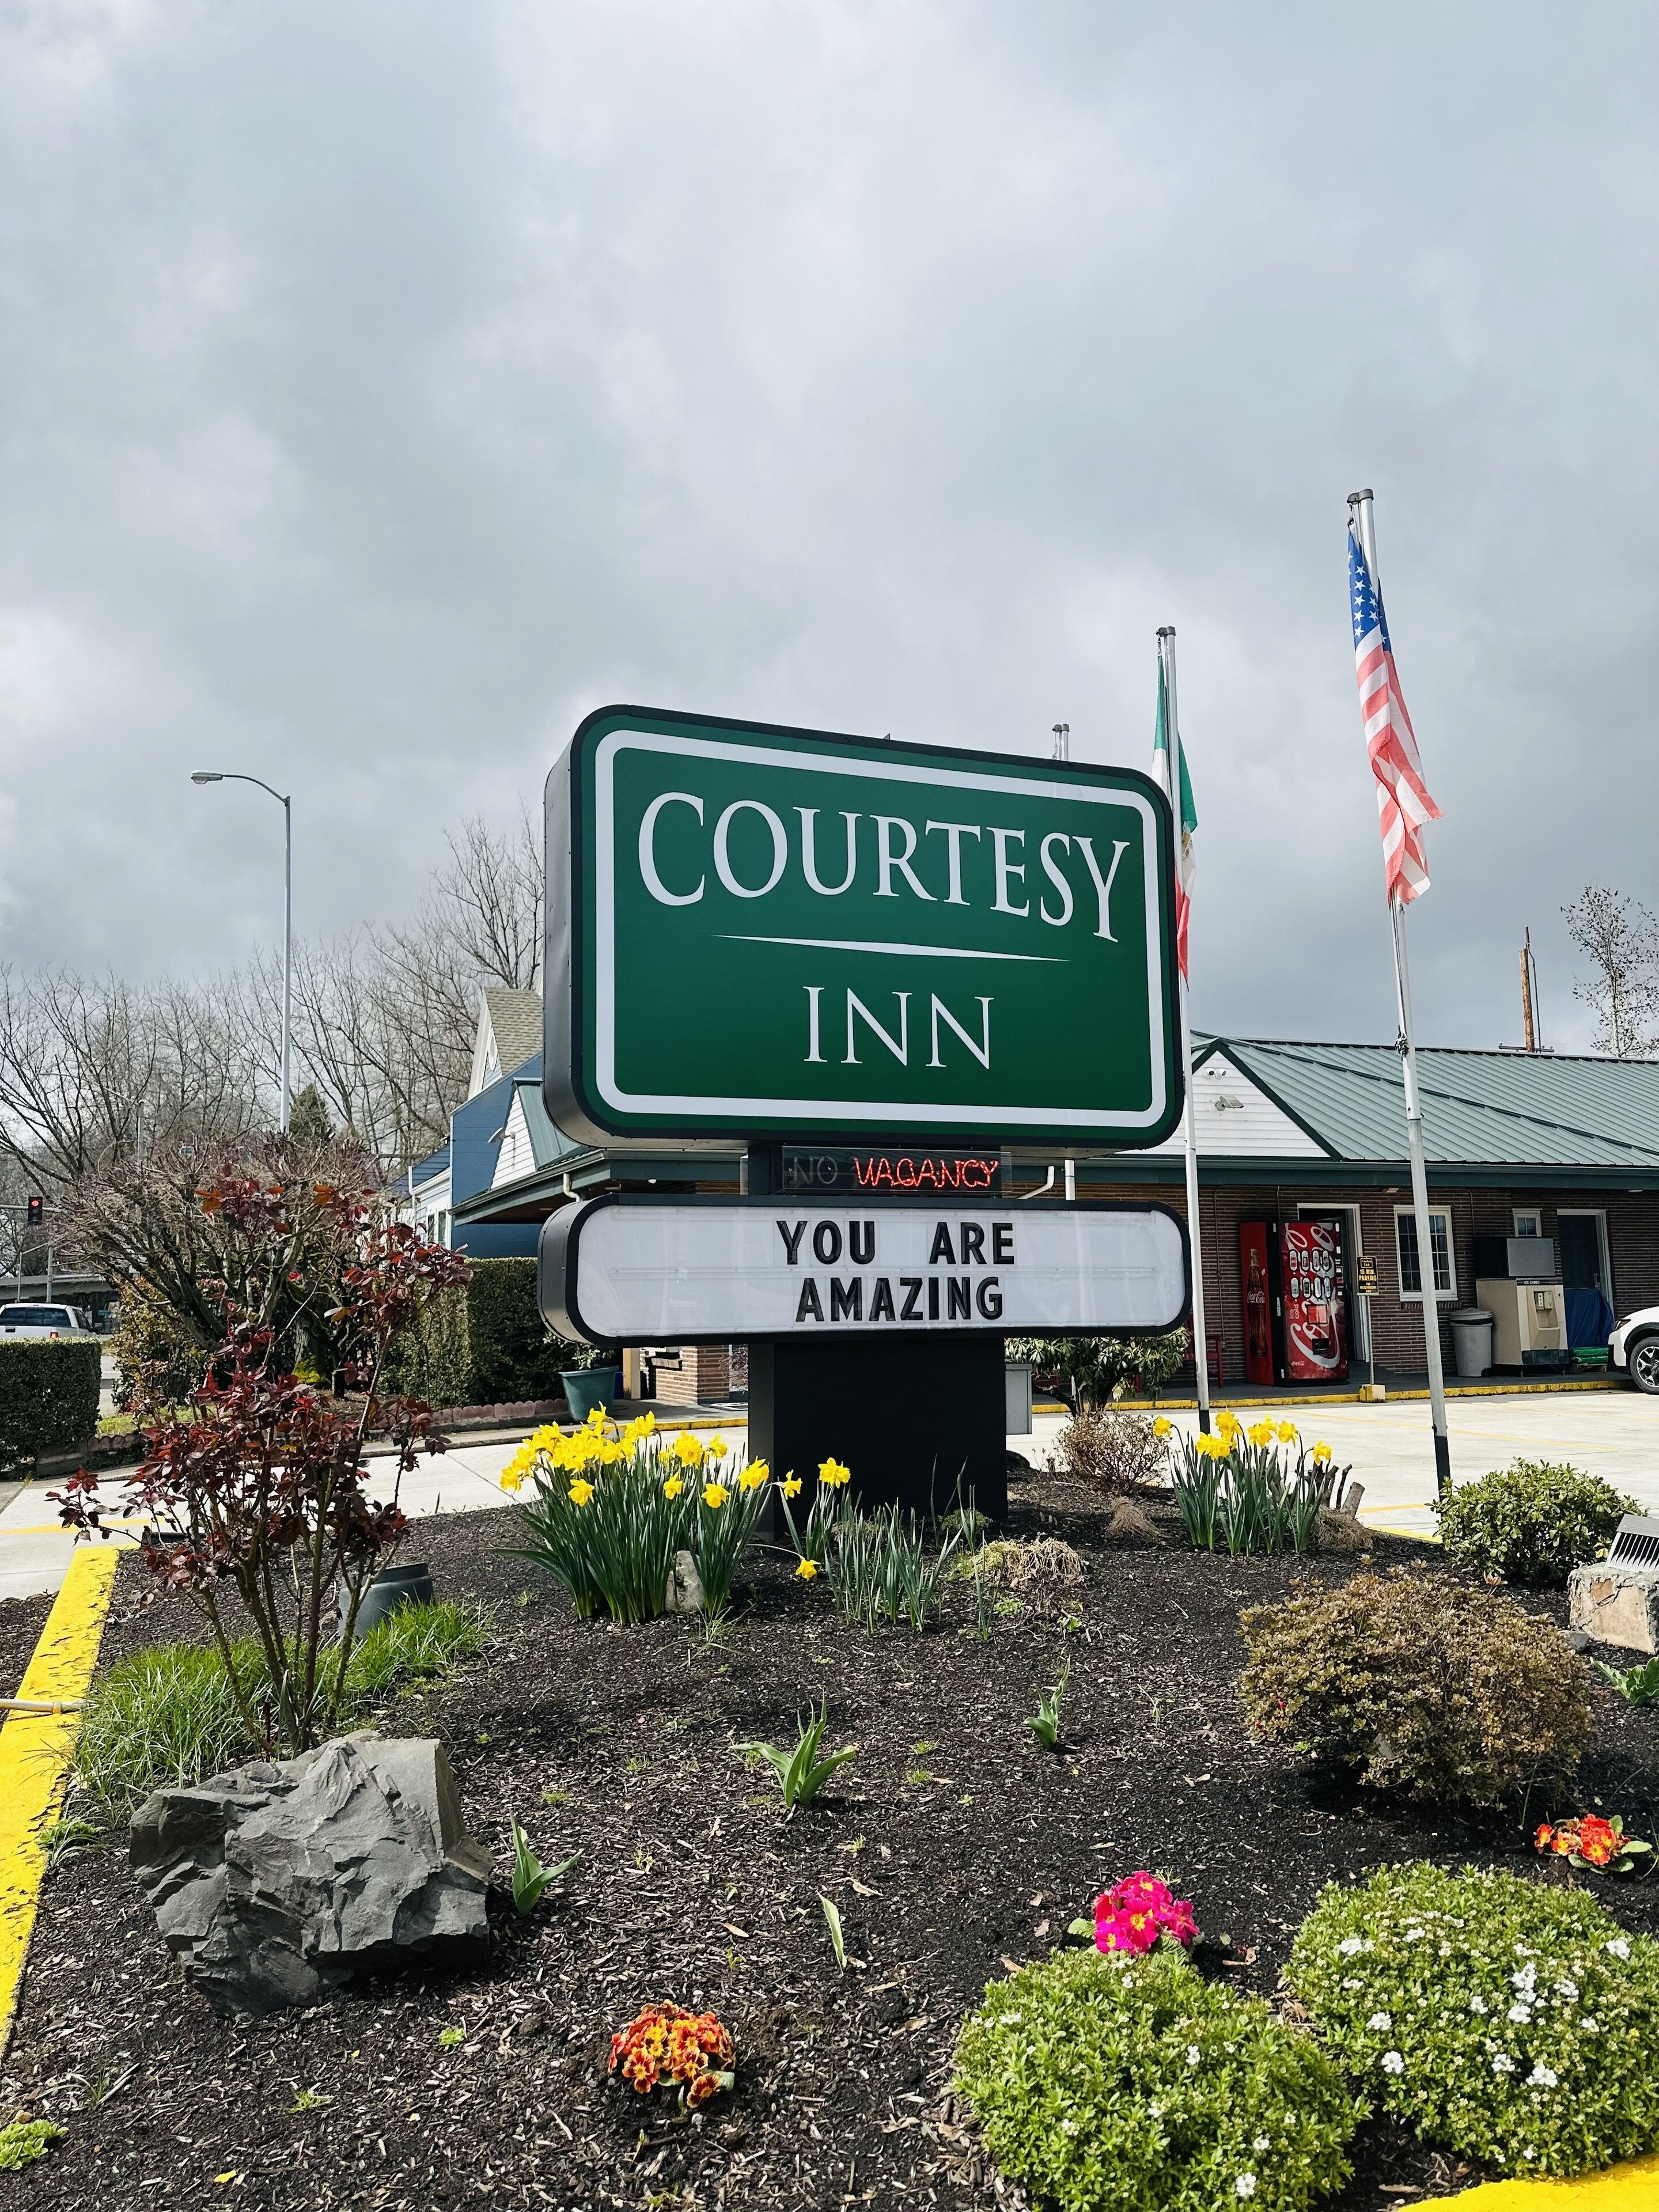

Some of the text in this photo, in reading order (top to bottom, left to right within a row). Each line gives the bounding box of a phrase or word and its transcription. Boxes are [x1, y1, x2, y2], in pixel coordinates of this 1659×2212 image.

[638, 792, 1130, 943] COURTESY
[802, 986, 994, 1070] INN
[791, 1157, 838, 1184] NO
[777, 1221, 1014, 1265] YOU ARE
[796, 1277, 1003, 1322] AMAZING
